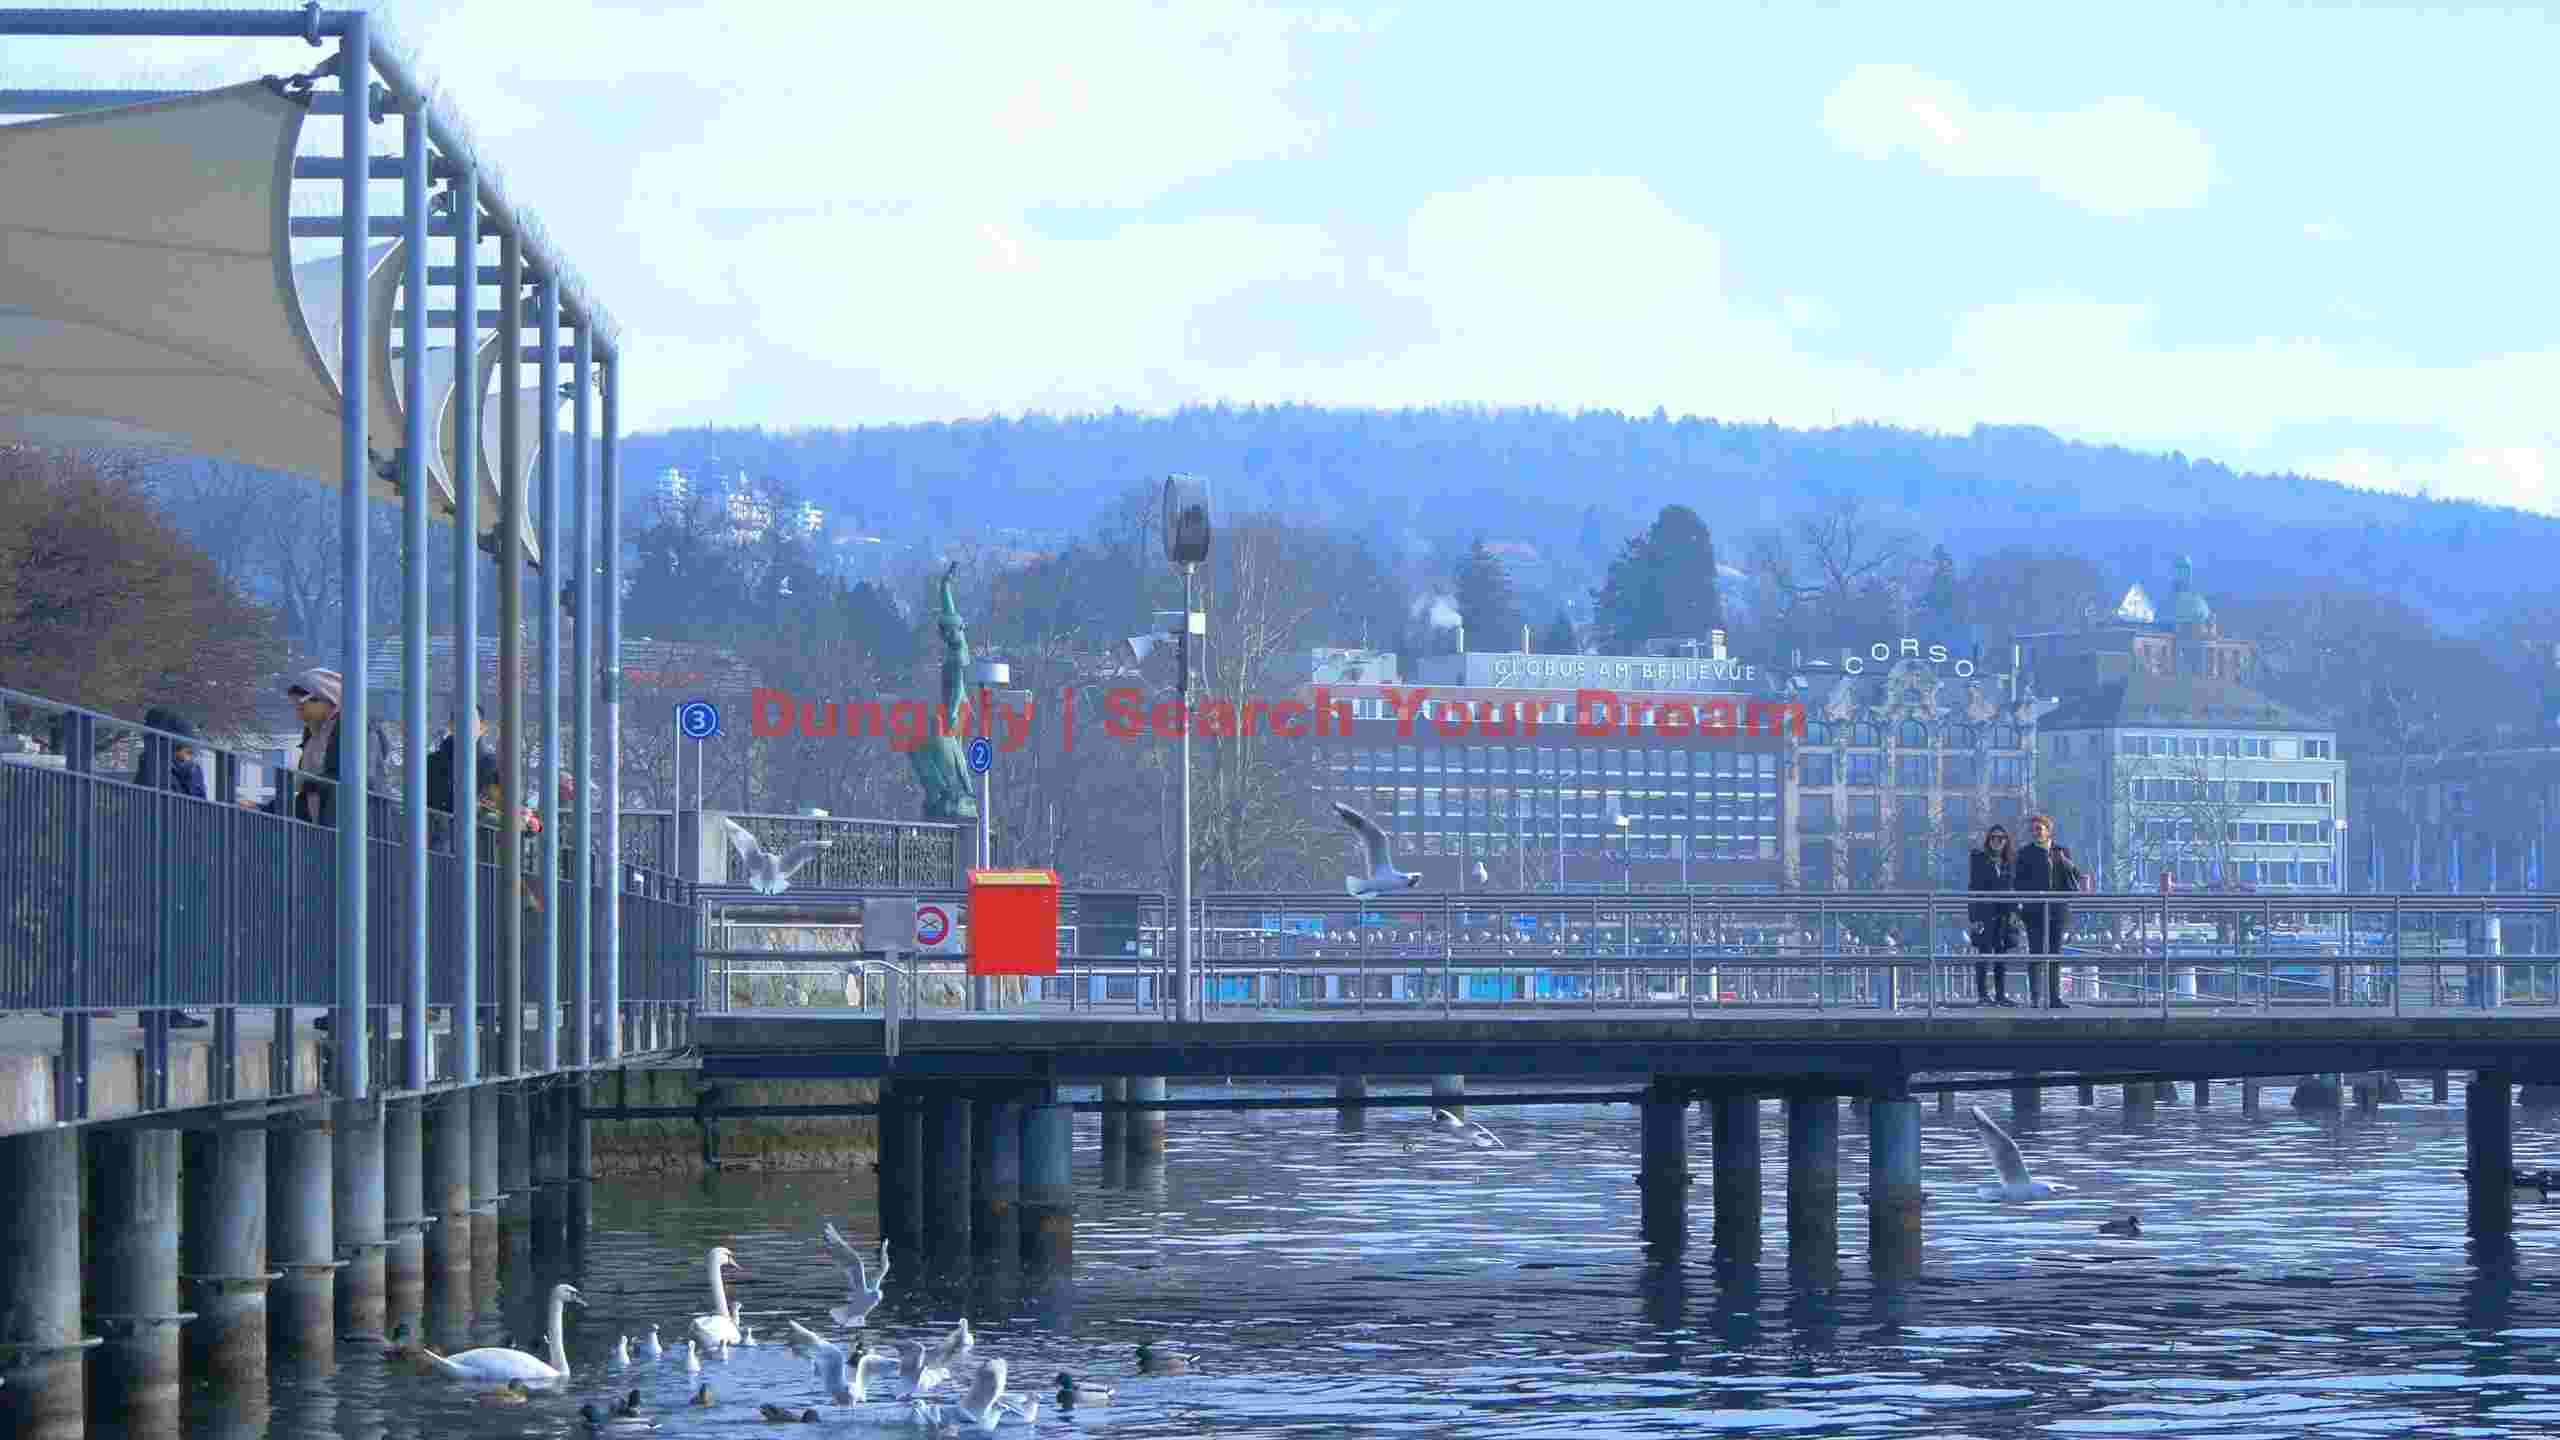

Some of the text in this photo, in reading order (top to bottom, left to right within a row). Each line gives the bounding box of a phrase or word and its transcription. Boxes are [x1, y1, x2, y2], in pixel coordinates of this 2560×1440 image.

[1846, 638, 1974, 677] CORSO
[1495, 659, 1756, 682] GLOBUS AM BELLEVUE
[690, 710, 705, 730] 3
[975, 745, 986, 764] 2
